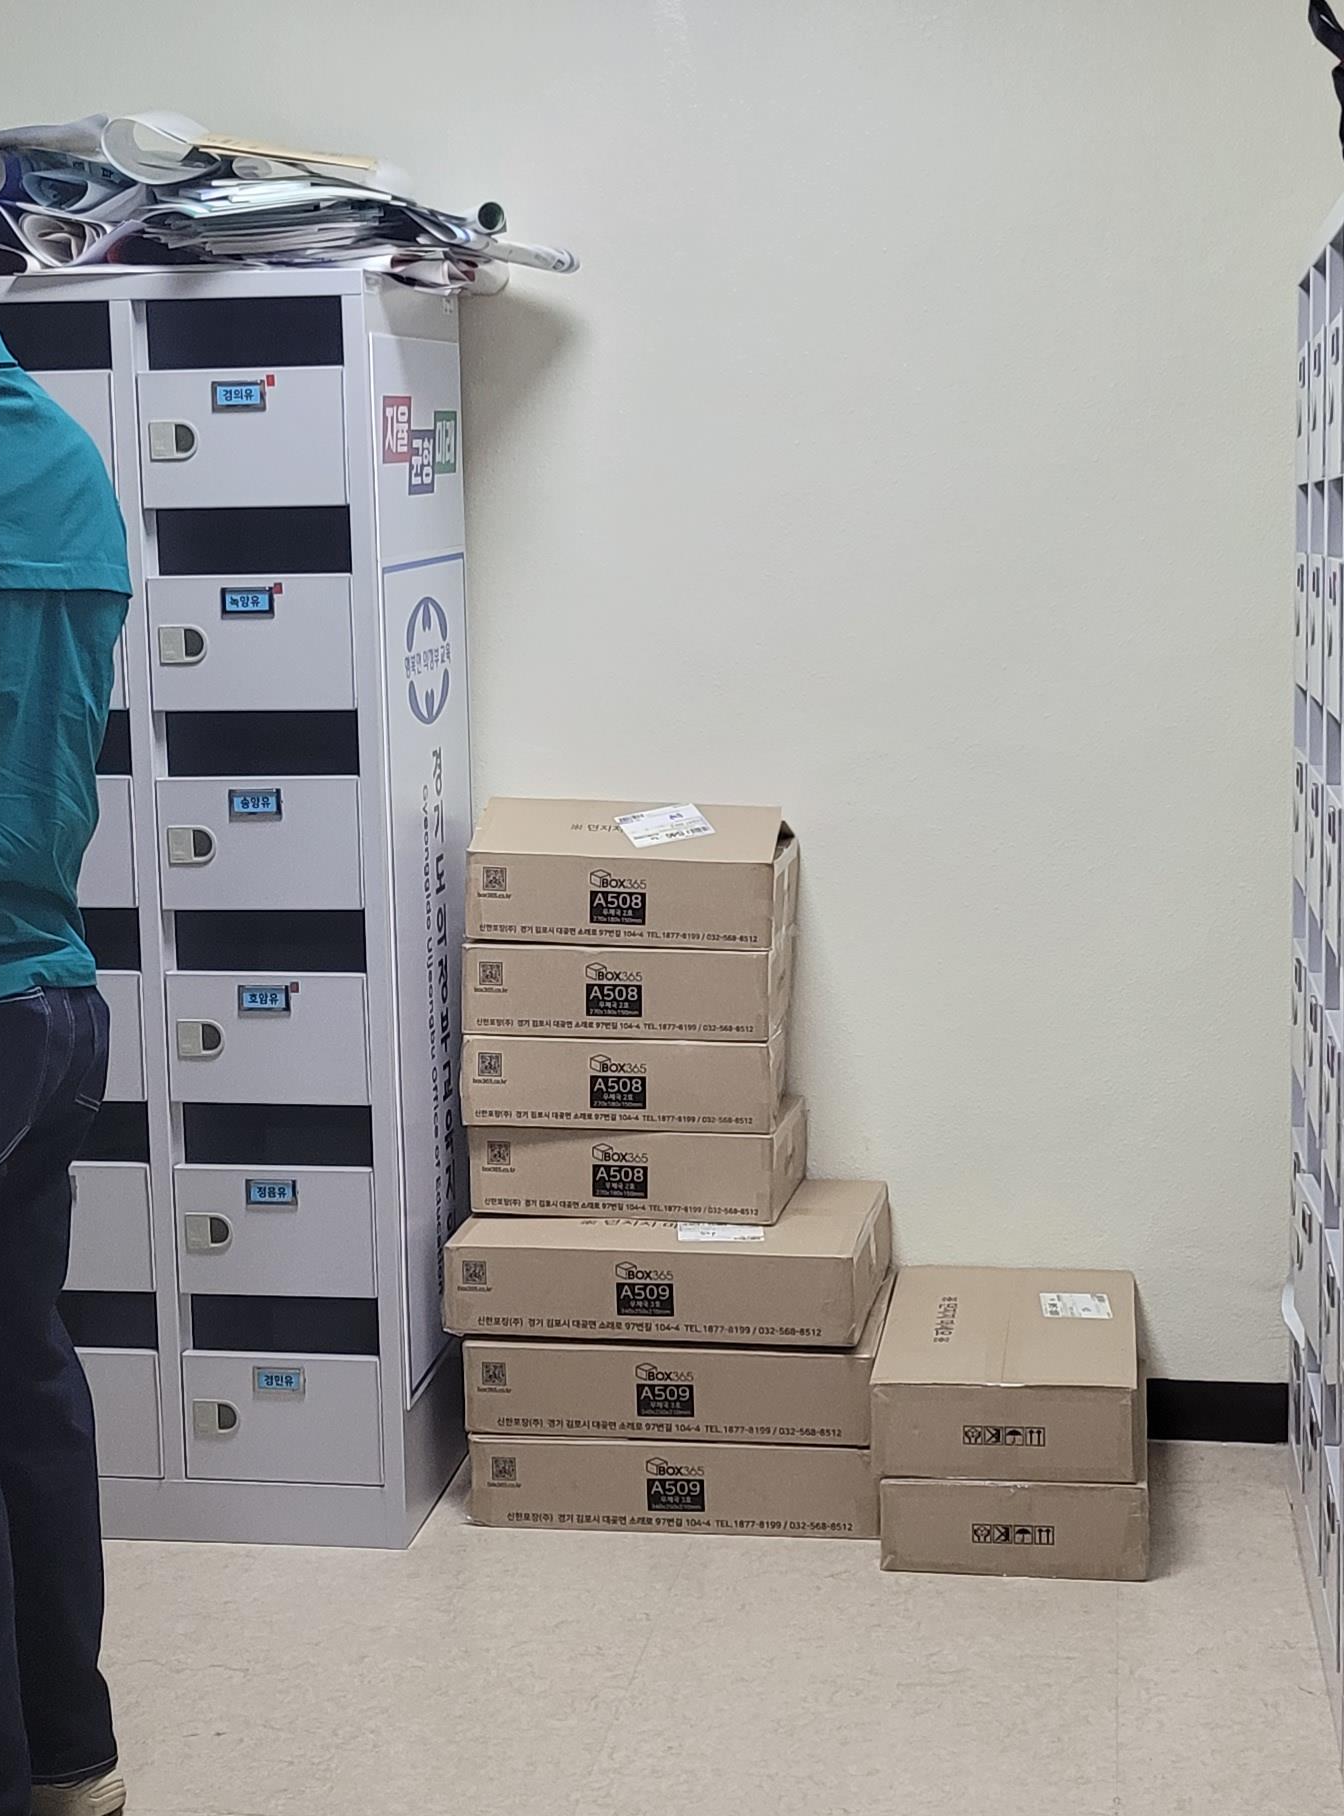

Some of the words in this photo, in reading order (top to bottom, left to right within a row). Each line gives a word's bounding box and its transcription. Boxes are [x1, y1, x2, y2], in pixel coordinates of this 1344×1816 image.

[223, 388, 254, 402] 경의유
[411, 437, 433, 485] 균형
[602, 878, 646, 889] BOX365
[593, 892, 642, 909] A508
[598, 971, 642, 982] BOX365
[248, 991, 279, 1005] 호암유
[590, 985, 638, 1001] A508
[602, 1063, 646, 1073] BOX365
[594, 1077, 642, 1093] A508
[604, 1152, 648, 1163] BOX365
[596, 1166, 644, 1182] A508
[627, 1270, 673, 1280] BOX365
[620, 1285, 670, 1300] A509
[478, 1317, 523, 1326] 신한포장(주)
[528, 1319, 543, 1327] 경기
[625, 1323, 652, 1331] 97번길
[758, 1327, 821, 1336] 032-568-8512
[647, 1371, 694, 1381] BOX365
[640, 1386, 689, 1401] A509
[497, 1418, 543, 1427] 신한포장(주)
[548, 1419, 563, 1428] 경기
[645, 1424, 672, 1432] 97번길
[676, 1424, 700, 1432] 104-4
[779, 1428, 842, 1436] 032-568-8512
[658, 1466, 704, 1476] BOX365
[651, 1481, 700, 1496] A509
[507, 1513, 553, 1522] 신한포장(주)
[558, 1514, 573, 1523] 경기
[655, 1518, 682, 1527] 97번길
[790, 1521, 852, 1530] 032-568-8512
